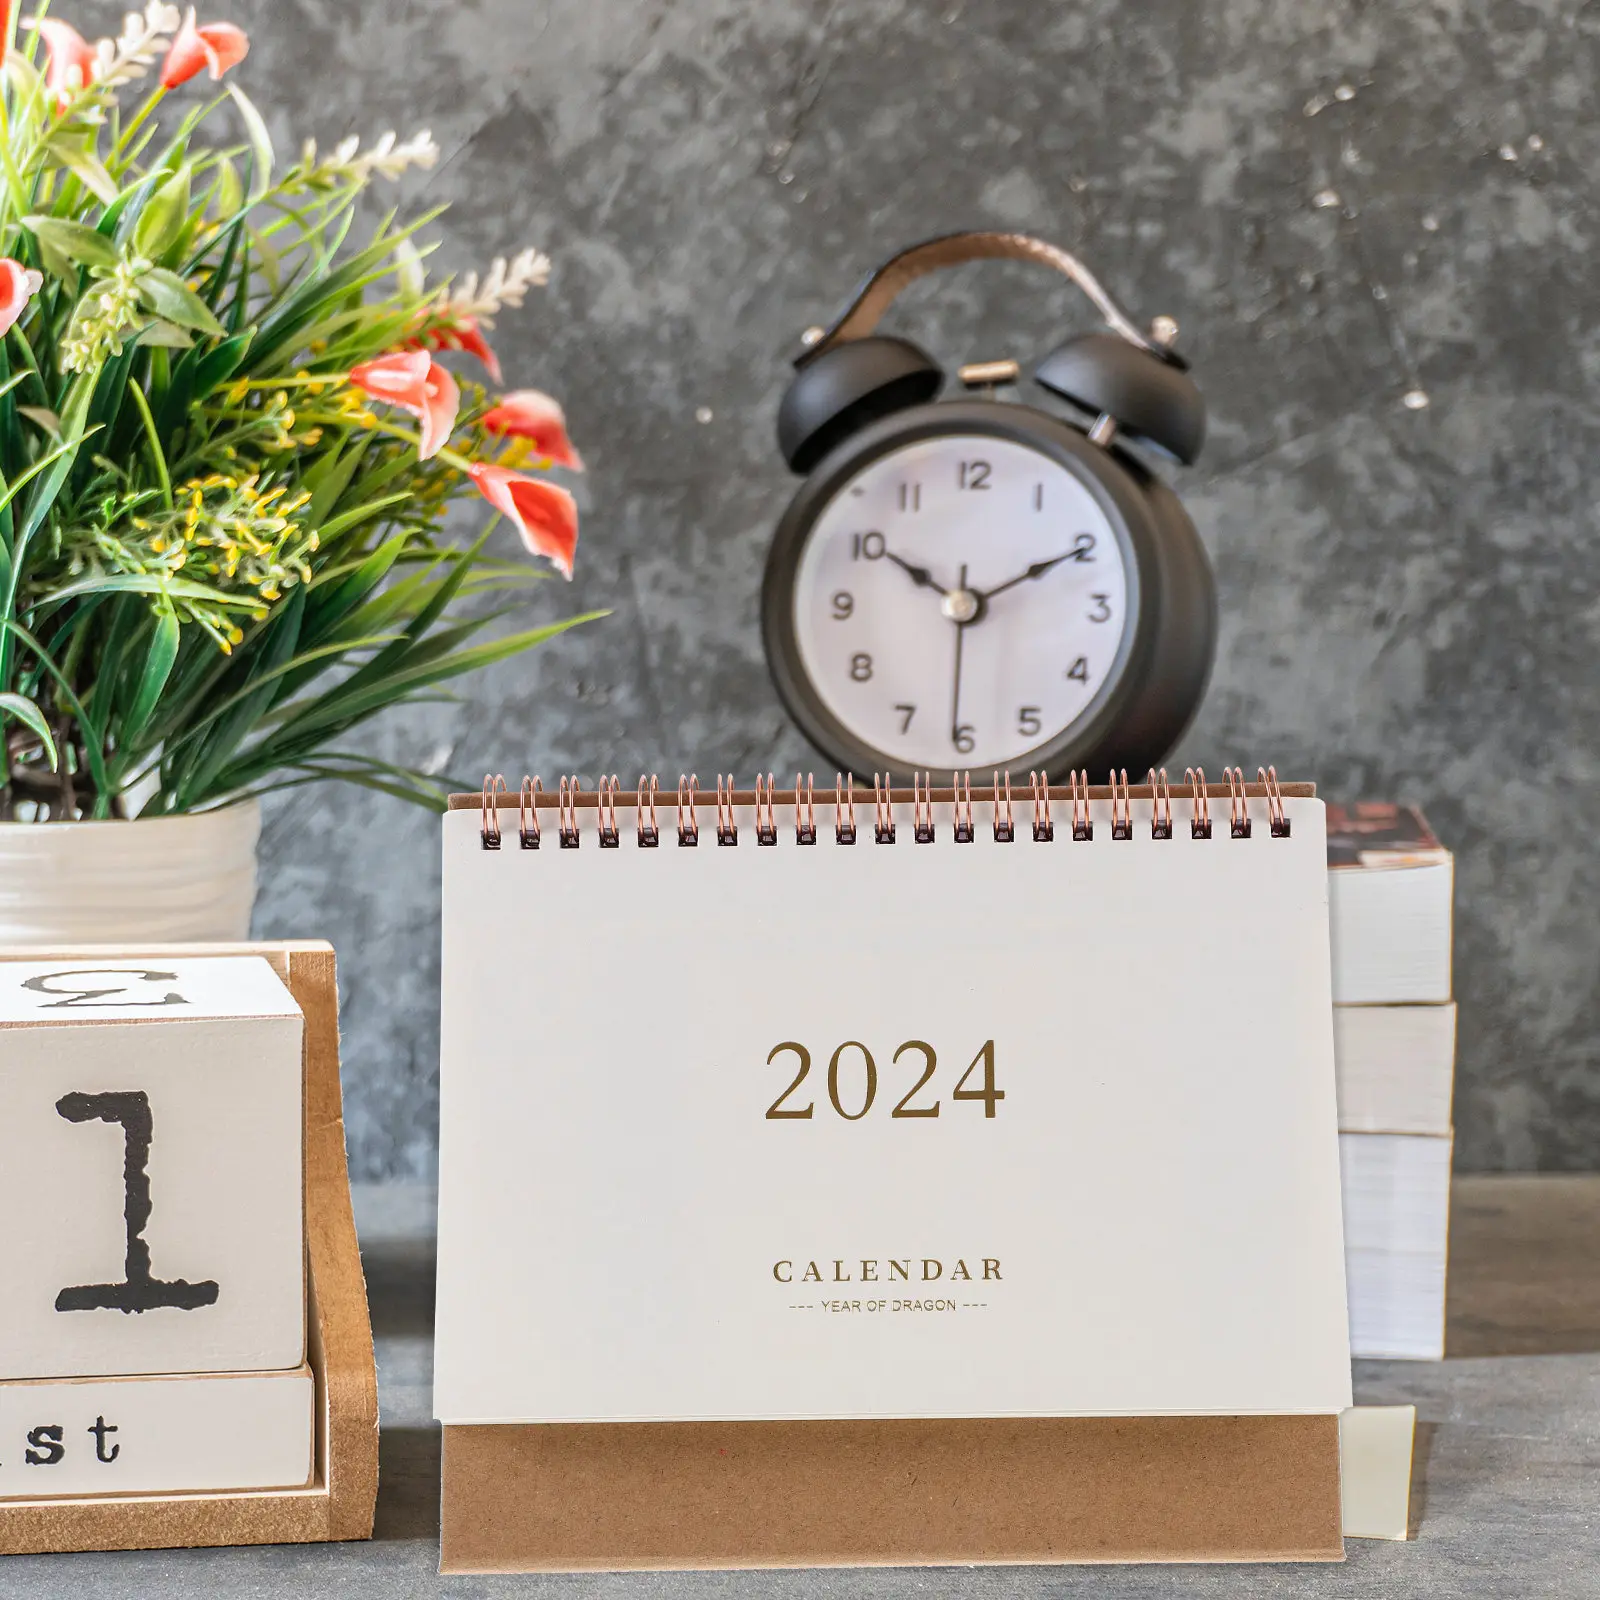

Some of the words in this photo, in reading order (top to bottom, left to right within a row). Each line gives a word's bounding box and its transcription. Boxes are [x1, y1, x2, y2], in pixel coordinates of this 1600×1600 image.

[959, 460, 991, 490] 12
[900, 483, 921, 512] 11
[1035, 483, 1044, 512] 1
[852, 531, 886, 561] 10
[1075, 533, 1097, 562] 2
[833, 591, 854, 620] 9
[1088, 594, 1112, 623] 3
[850, 653, 873, 682] 8
[1067, 657, 1089, 685] 4
[895, 704, 916, 735] 7
[1018, 707, 1042, 736] 5
[952, 725, 976, 754] 6
[765, 1039, 1005, 1120] 2024
[55, 1090, 219, 1314] 1
[772, 1258, 1004, 1283] CALENDAR
[821, 1300, 861, 1313] YEAR
[867, 1300, 887, 1312] OF
[892, 1299, 957, 1312] DRAGON
[0, 1415, 120, 1466] st
